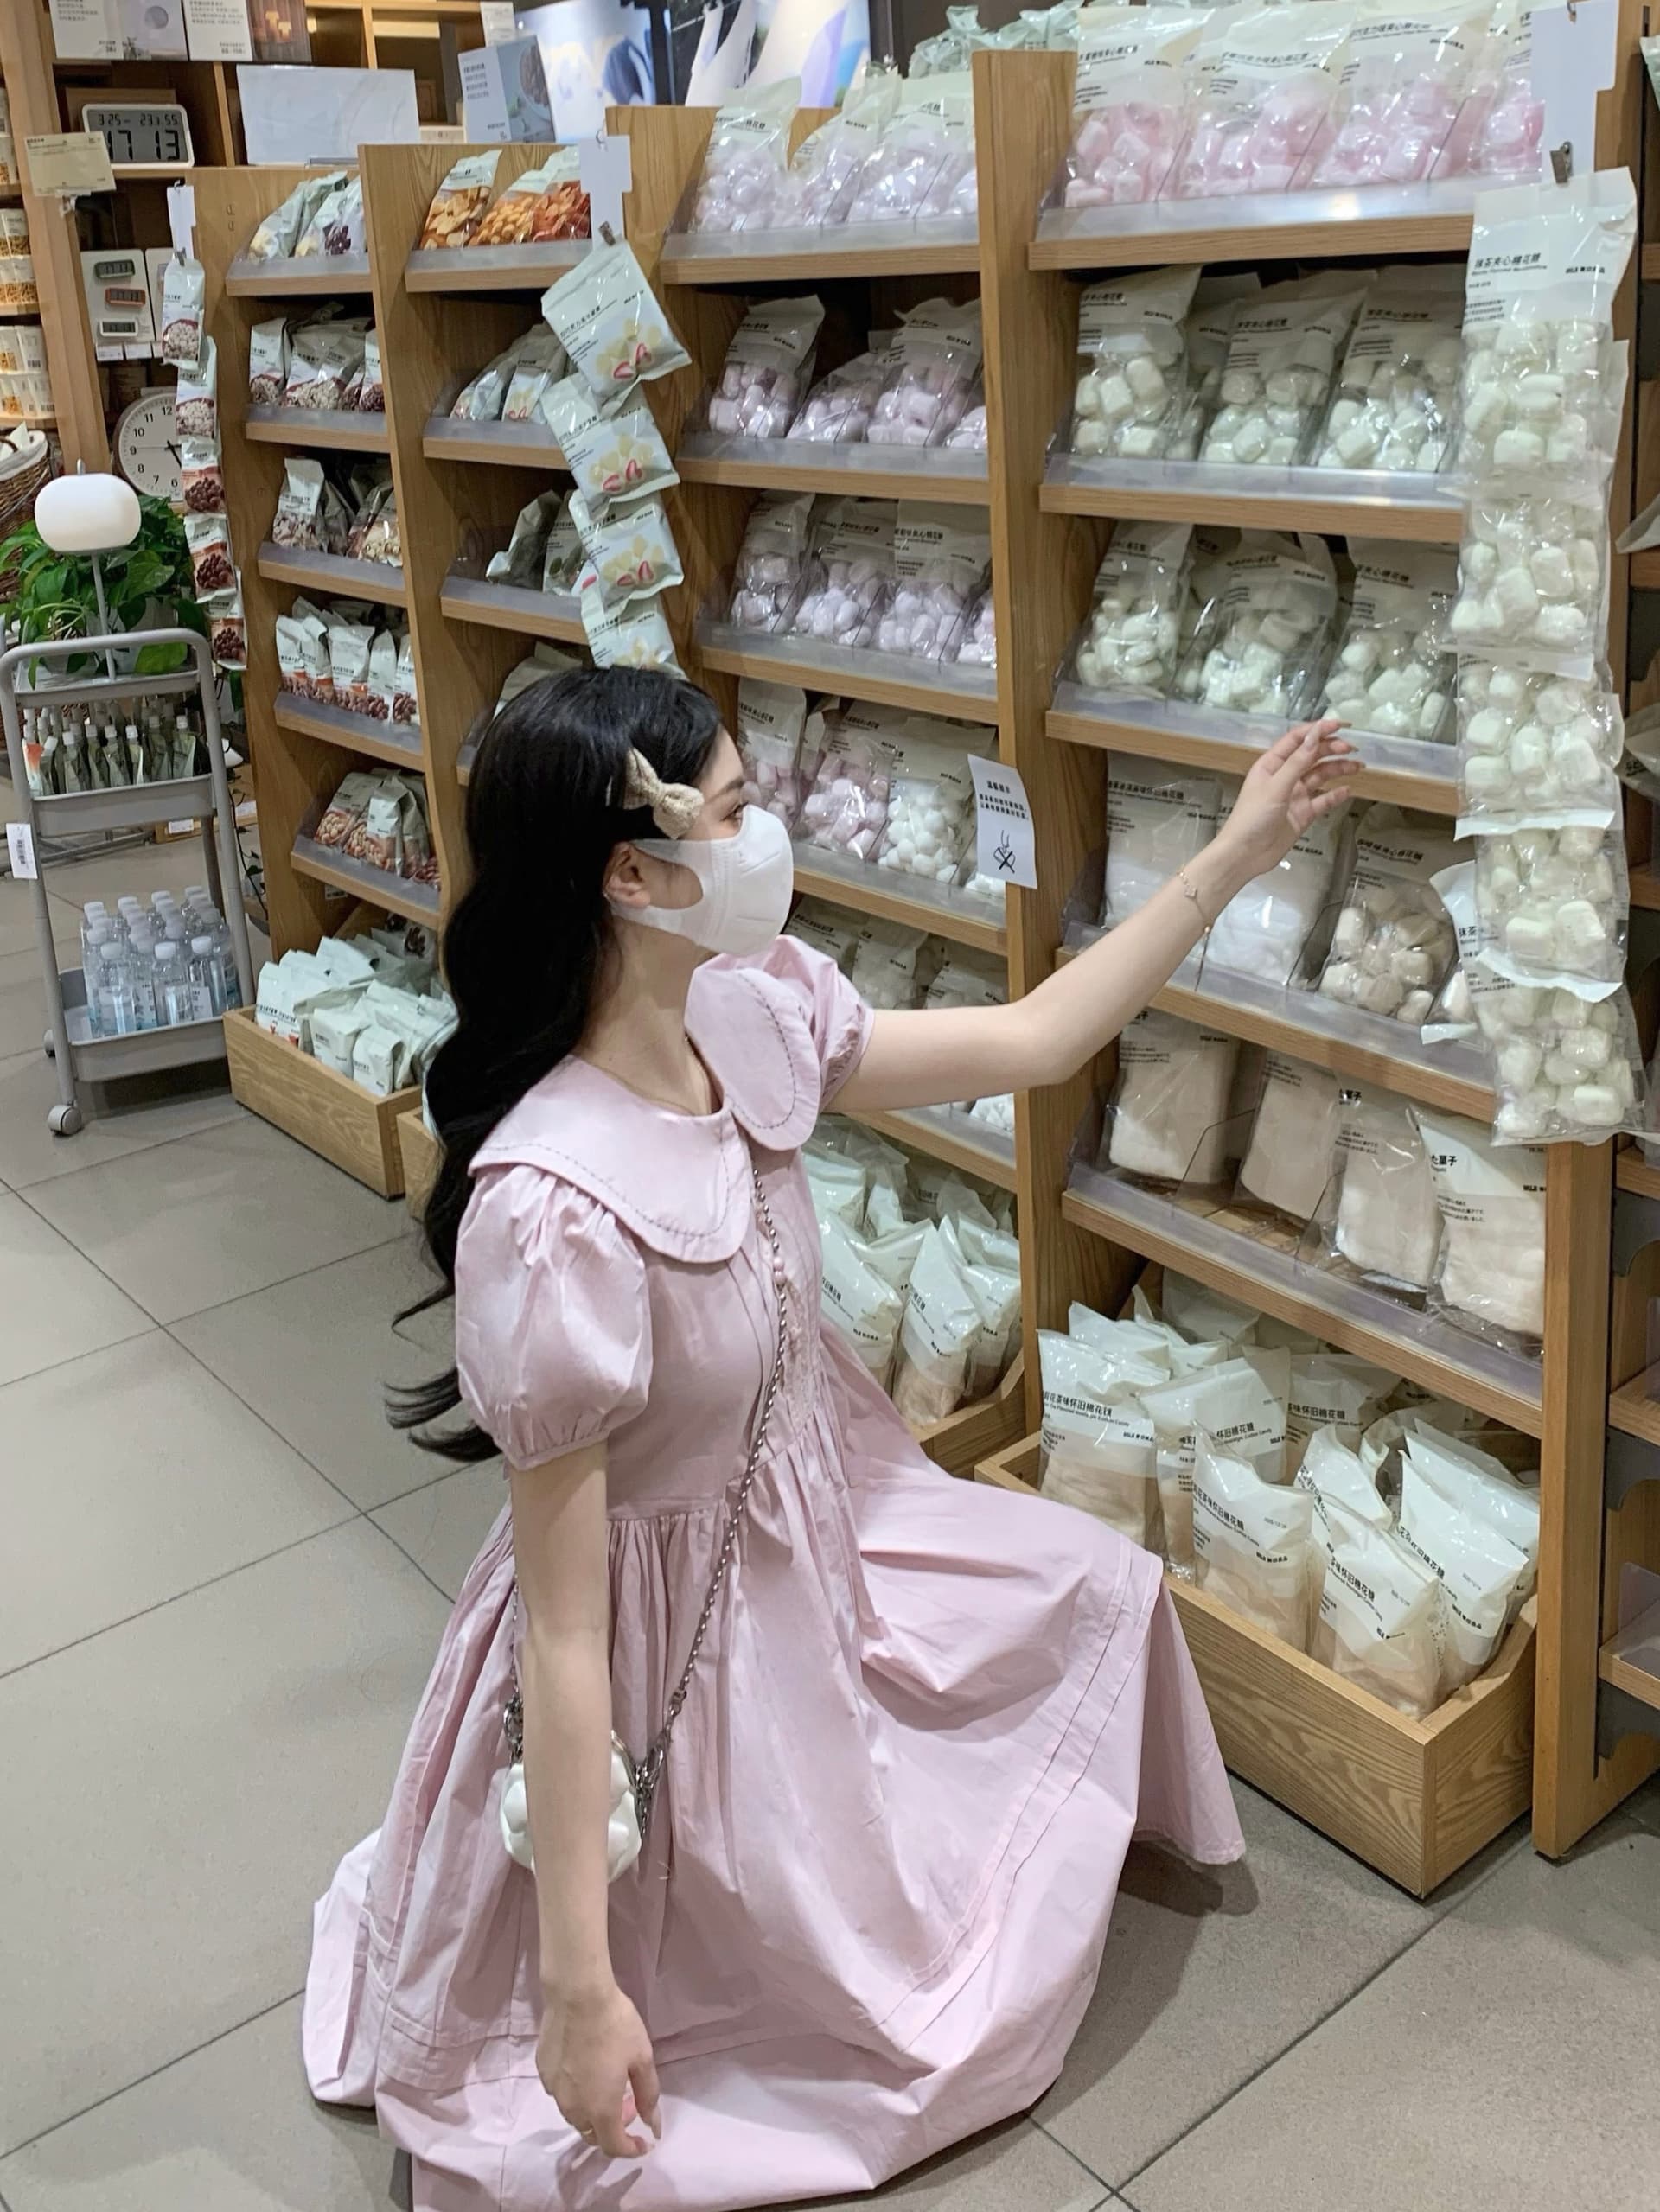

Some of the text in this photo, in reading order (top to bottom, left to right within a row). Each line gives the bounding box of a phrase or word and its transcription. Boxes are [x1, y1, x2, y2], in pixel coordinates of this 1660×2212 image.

[155, 131, 180, 160] 13
[163, 406, 172, 416] 12
[145, 413, 154, 423] 11
[133, 428, 145, 437] 10
[130, 446, 137, 455] 9
[137, 463, 145, 473] 8
[153, 475, 159, 484] 7
[171, 478, 178, 488] 6
